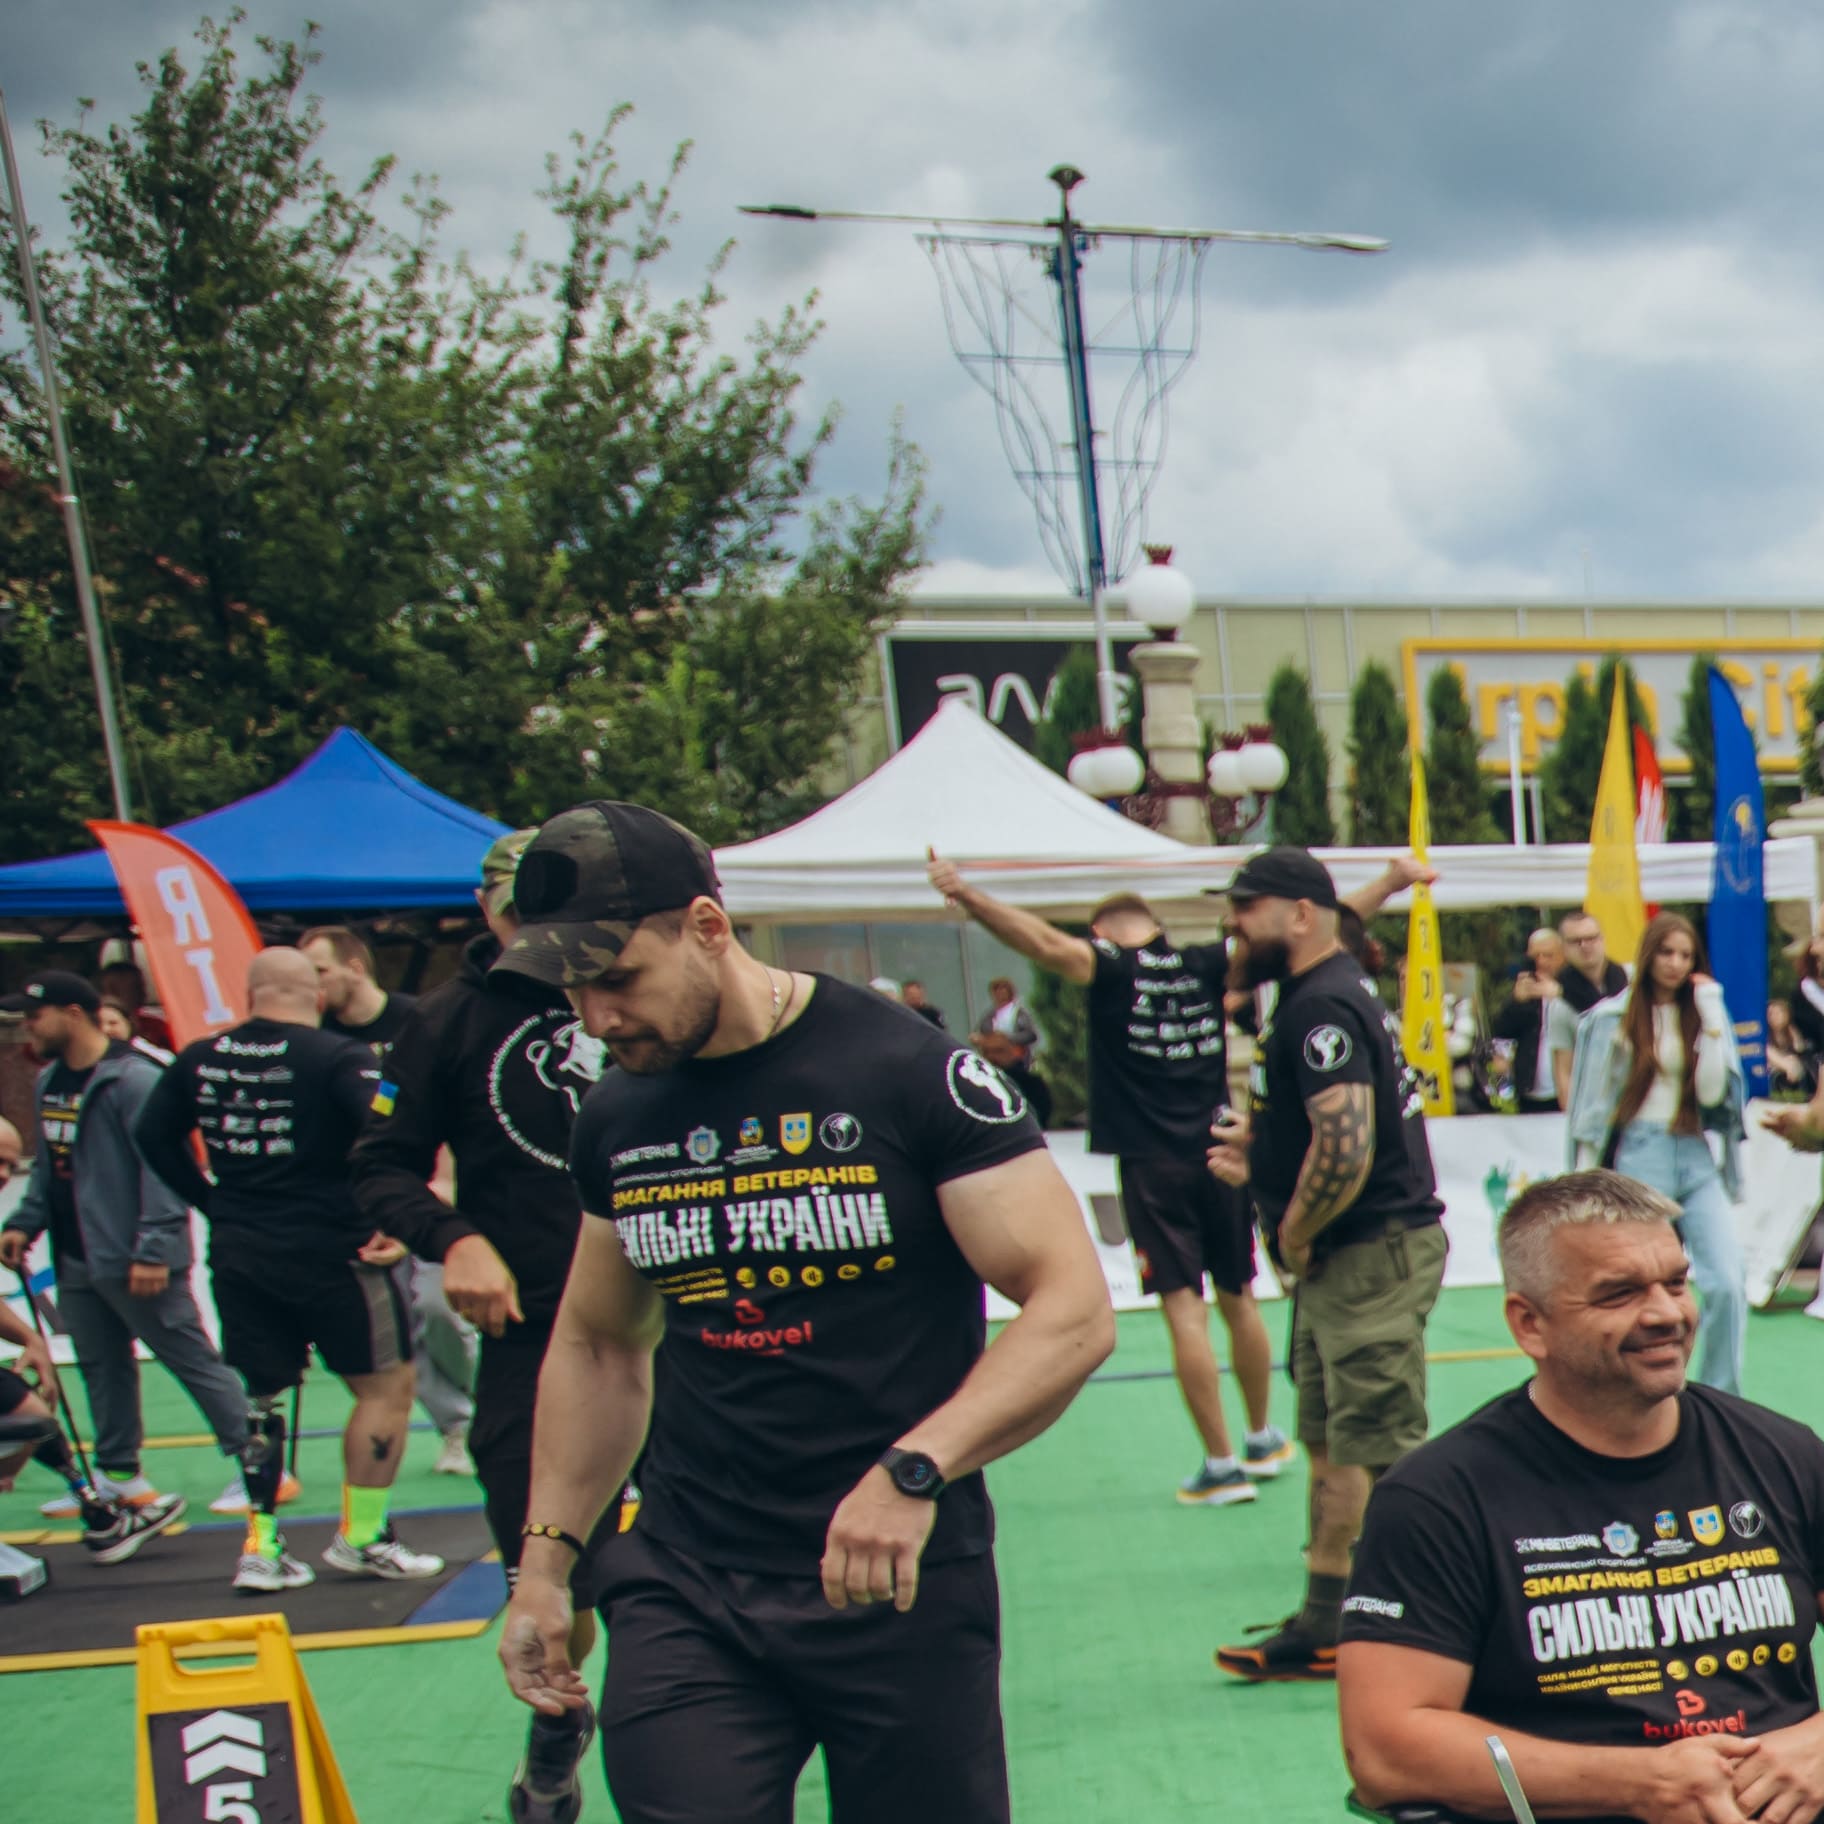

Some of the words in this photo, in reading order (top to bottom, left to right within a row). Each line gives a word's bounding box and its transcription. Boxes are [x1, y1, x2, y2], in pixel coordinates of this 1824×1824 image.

[733, 1164, 879, 1194] ВЕТЕРАНІВ
[723, 1184, 895, 1254] УКРАЇНИ
[1522, 1569, 1654, 1598] ЗМАГАННЯ
[1655, 1546, 1781, 1587] ВЕТЕРАНІВ
[1527, 1594, 1656, 1664] СИЛЬНІ
[1654, 1568, 1796, 1647] УКРАЇНИ
[1643, 1710, 1747, 1740] bukovel
